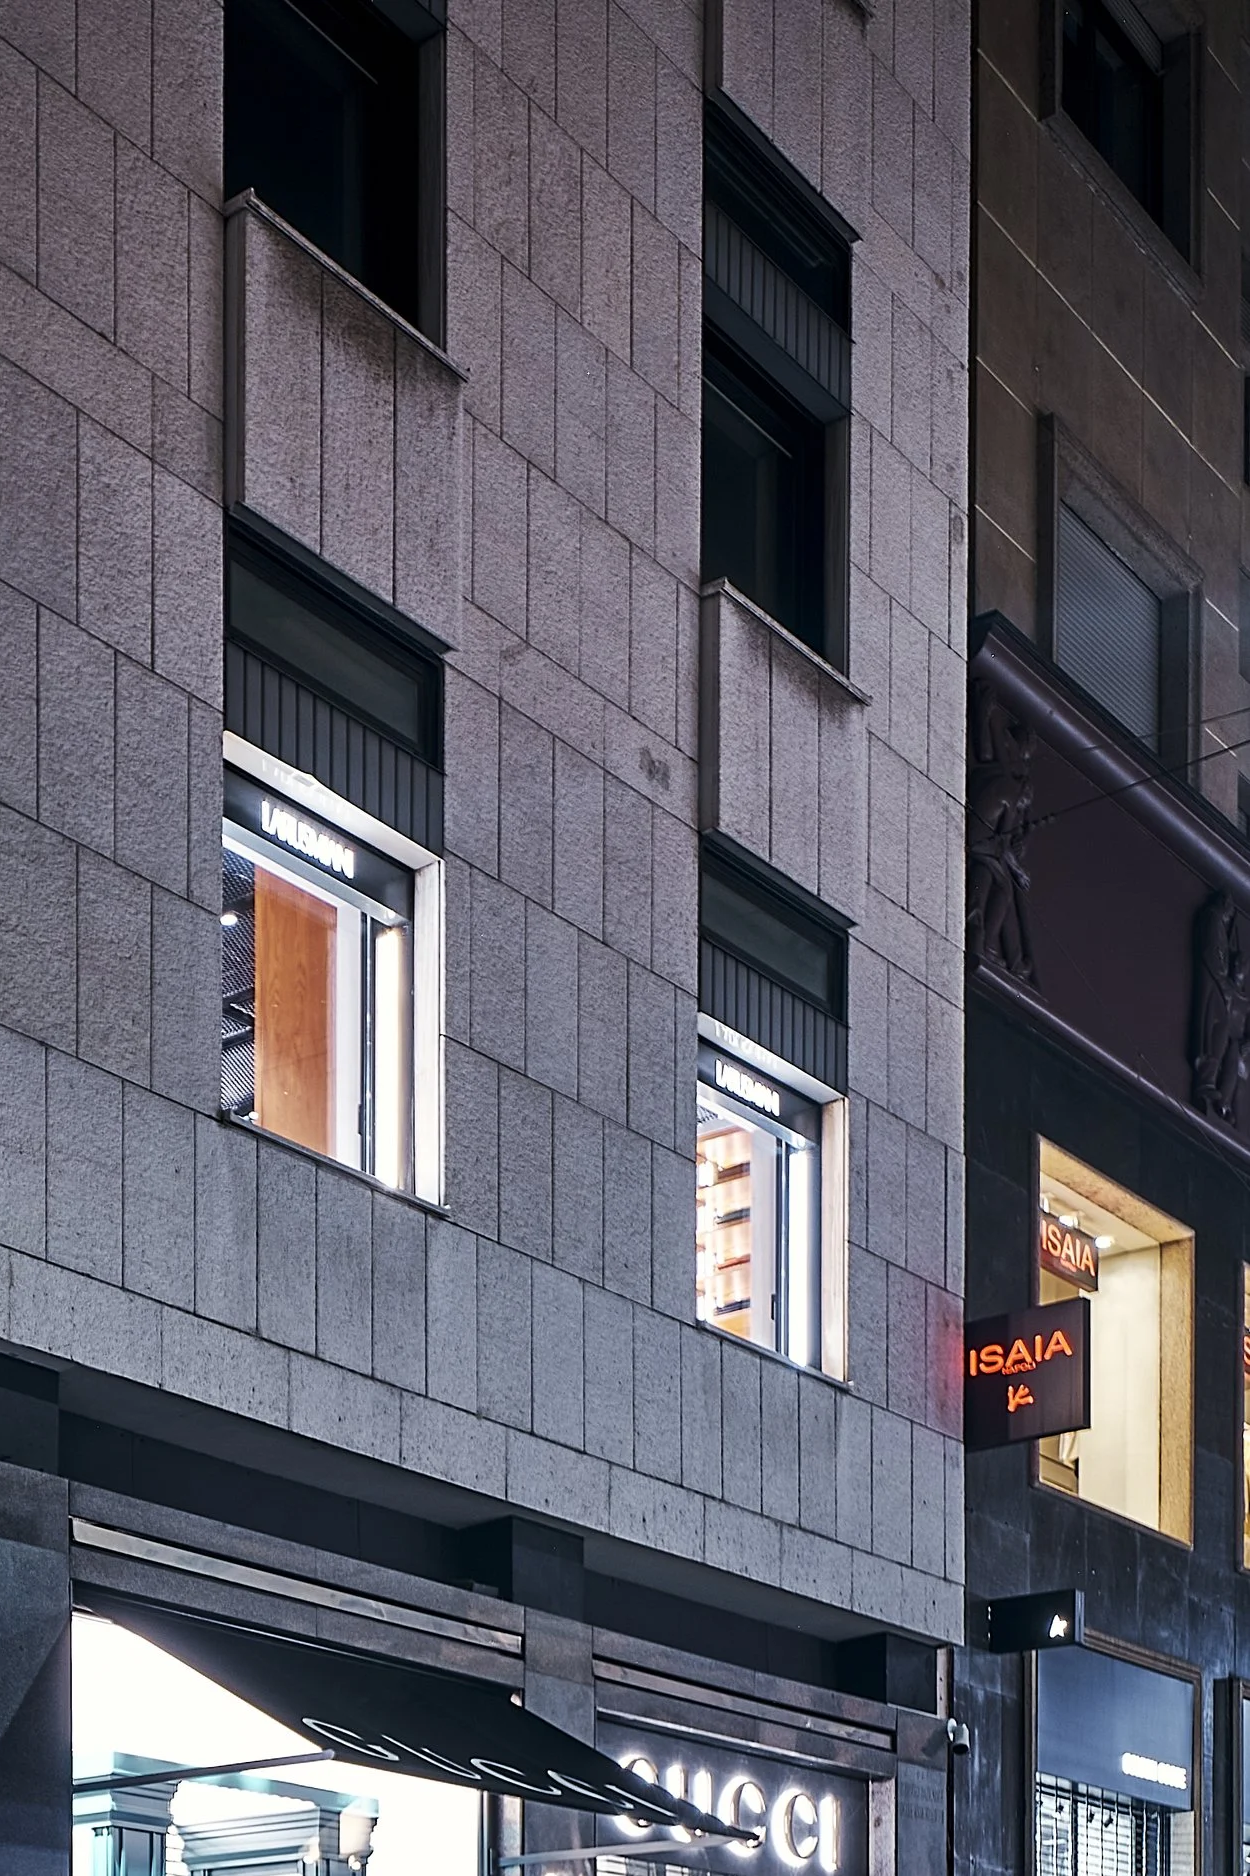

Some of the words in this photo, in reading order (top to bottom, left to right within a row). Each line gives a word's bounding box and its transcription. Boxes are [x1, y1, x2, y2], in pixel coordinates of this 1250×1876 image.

[1041, 1219, 1096, 1277] ISAIA
[969, 1329, 1073, 1377] ISAIA
[302, 1717, 678, 1819] GUCCI
